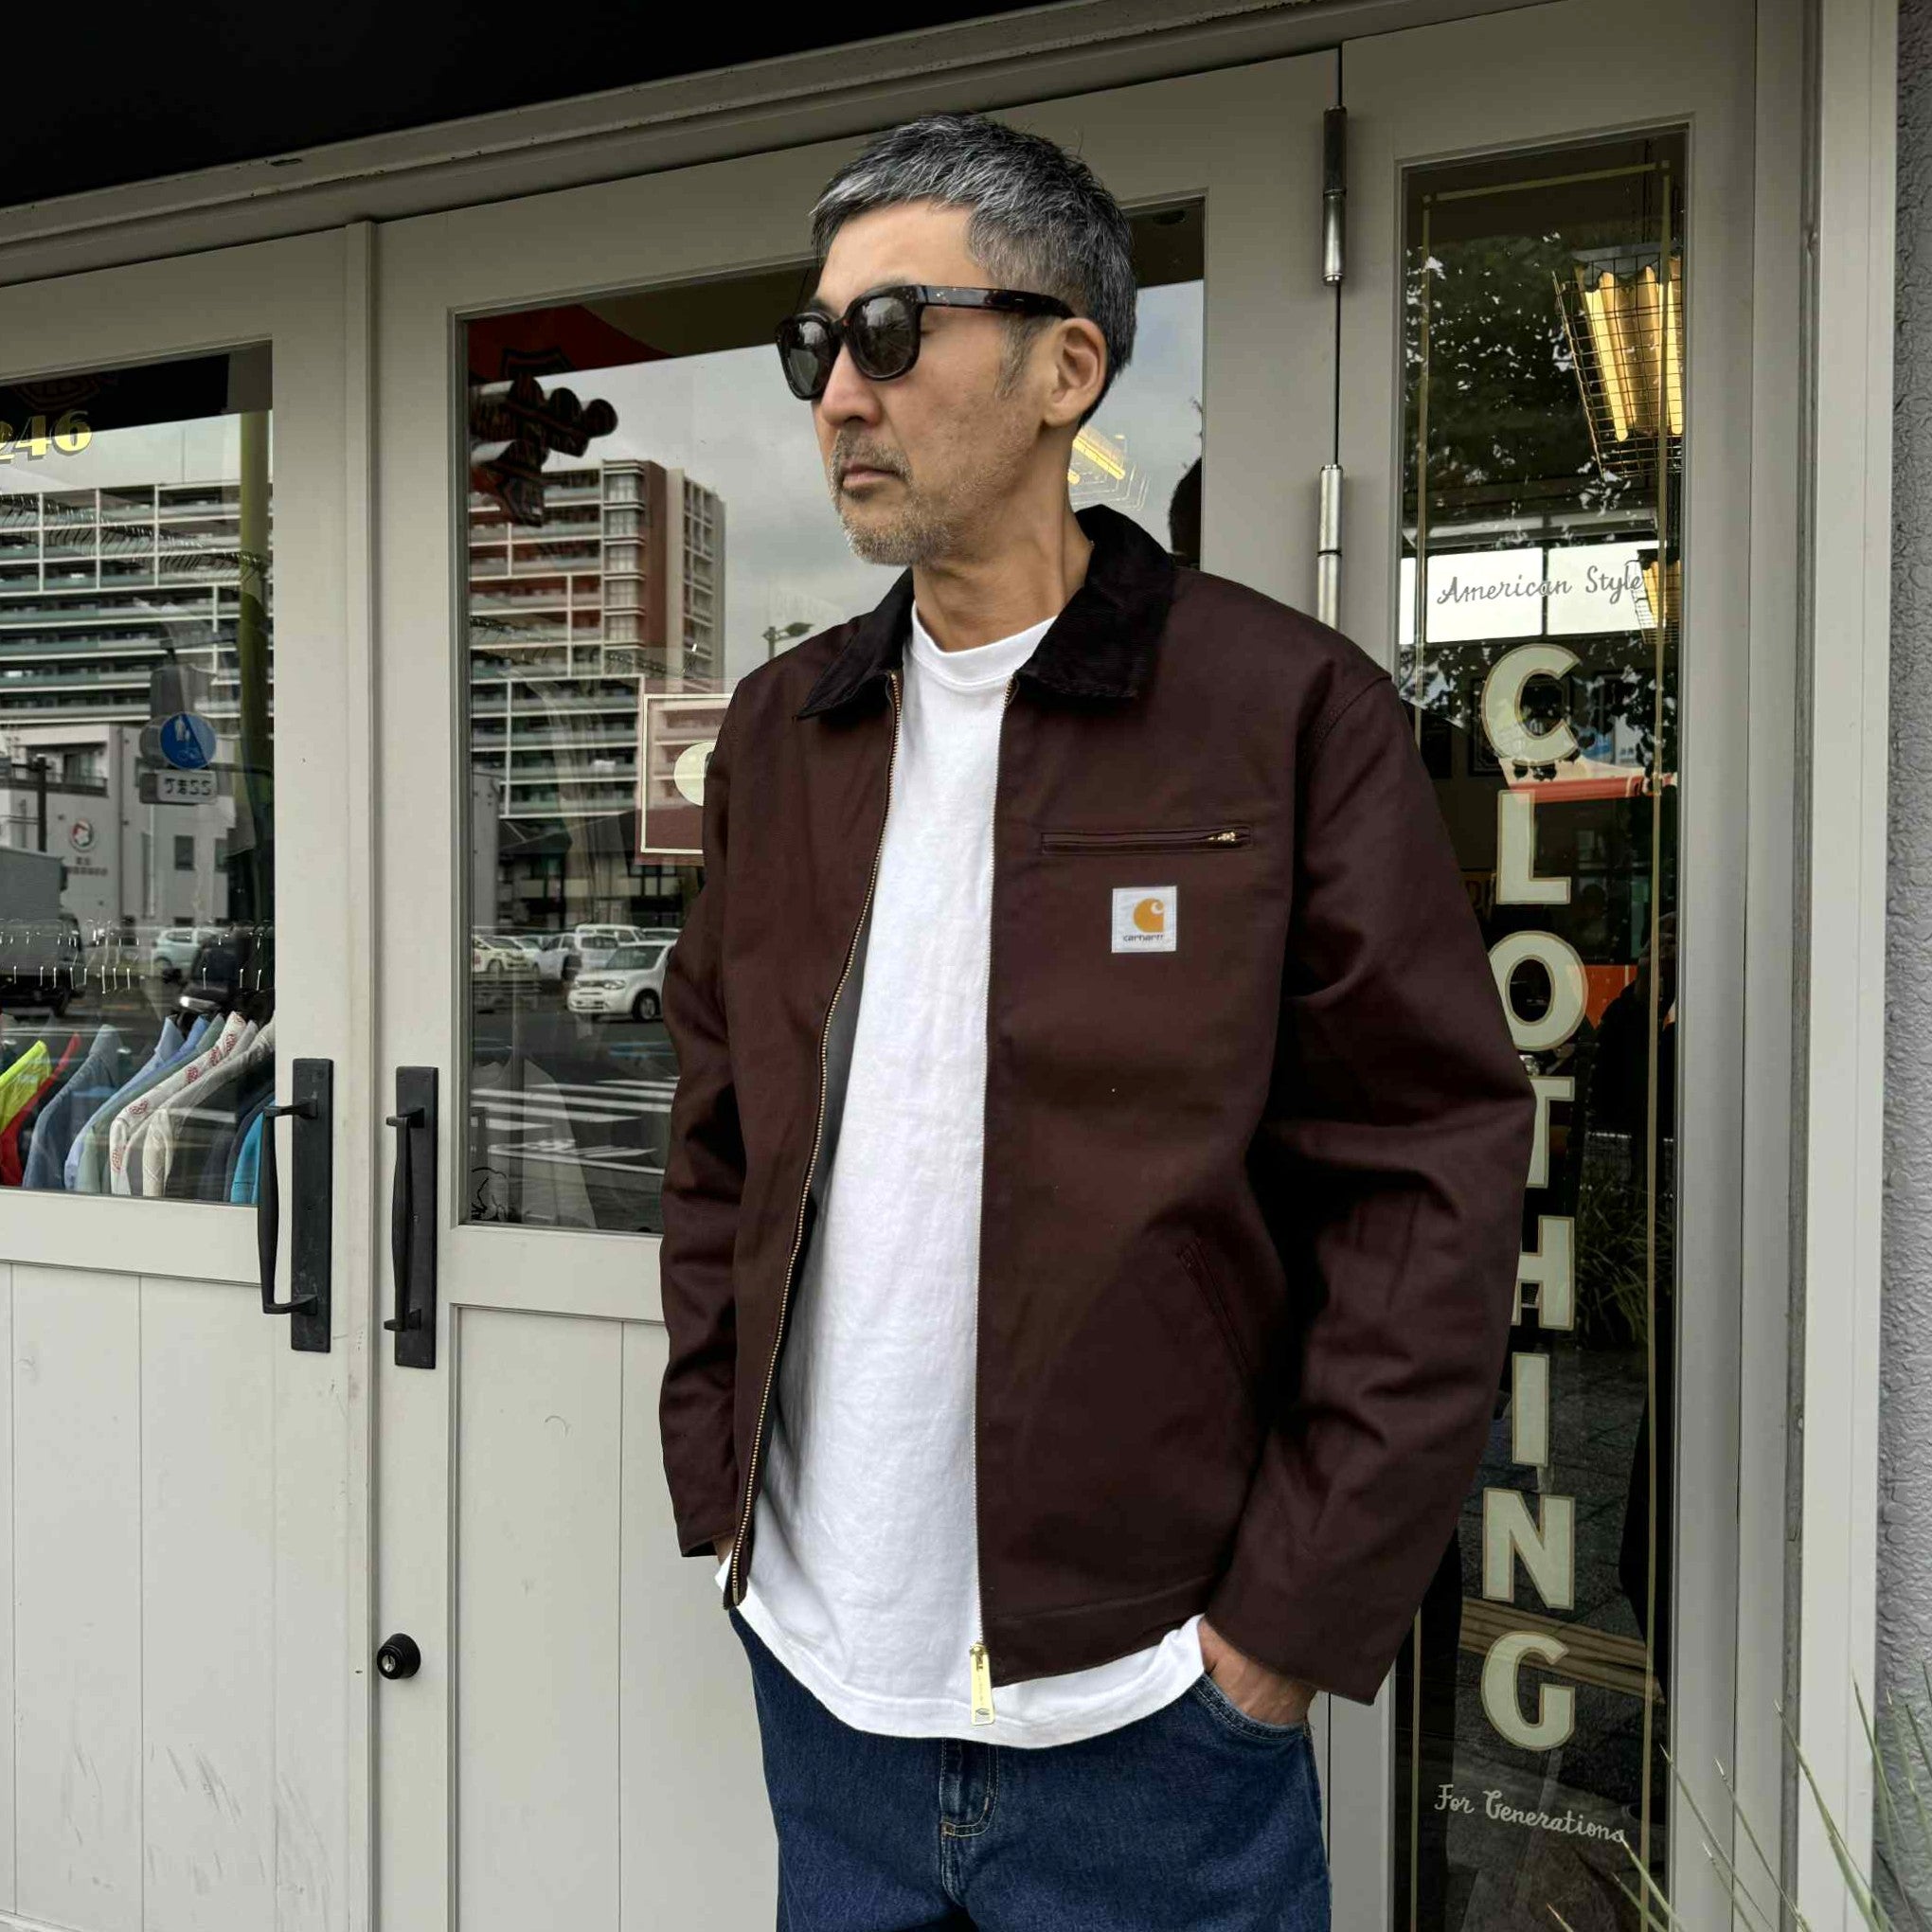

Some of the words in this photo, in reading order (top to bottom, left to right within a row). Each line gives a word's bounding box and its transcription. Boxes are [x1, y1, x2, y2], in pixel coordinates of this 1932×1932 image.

[1436, 573, 1573, 605] American
[1584, 564, 1644, 605] Style
[1122, 934, 1165, 942] carhartt
[1433, 1783, 1476, 1815] For
[1481, 1789, 1626, 1843] Generations
